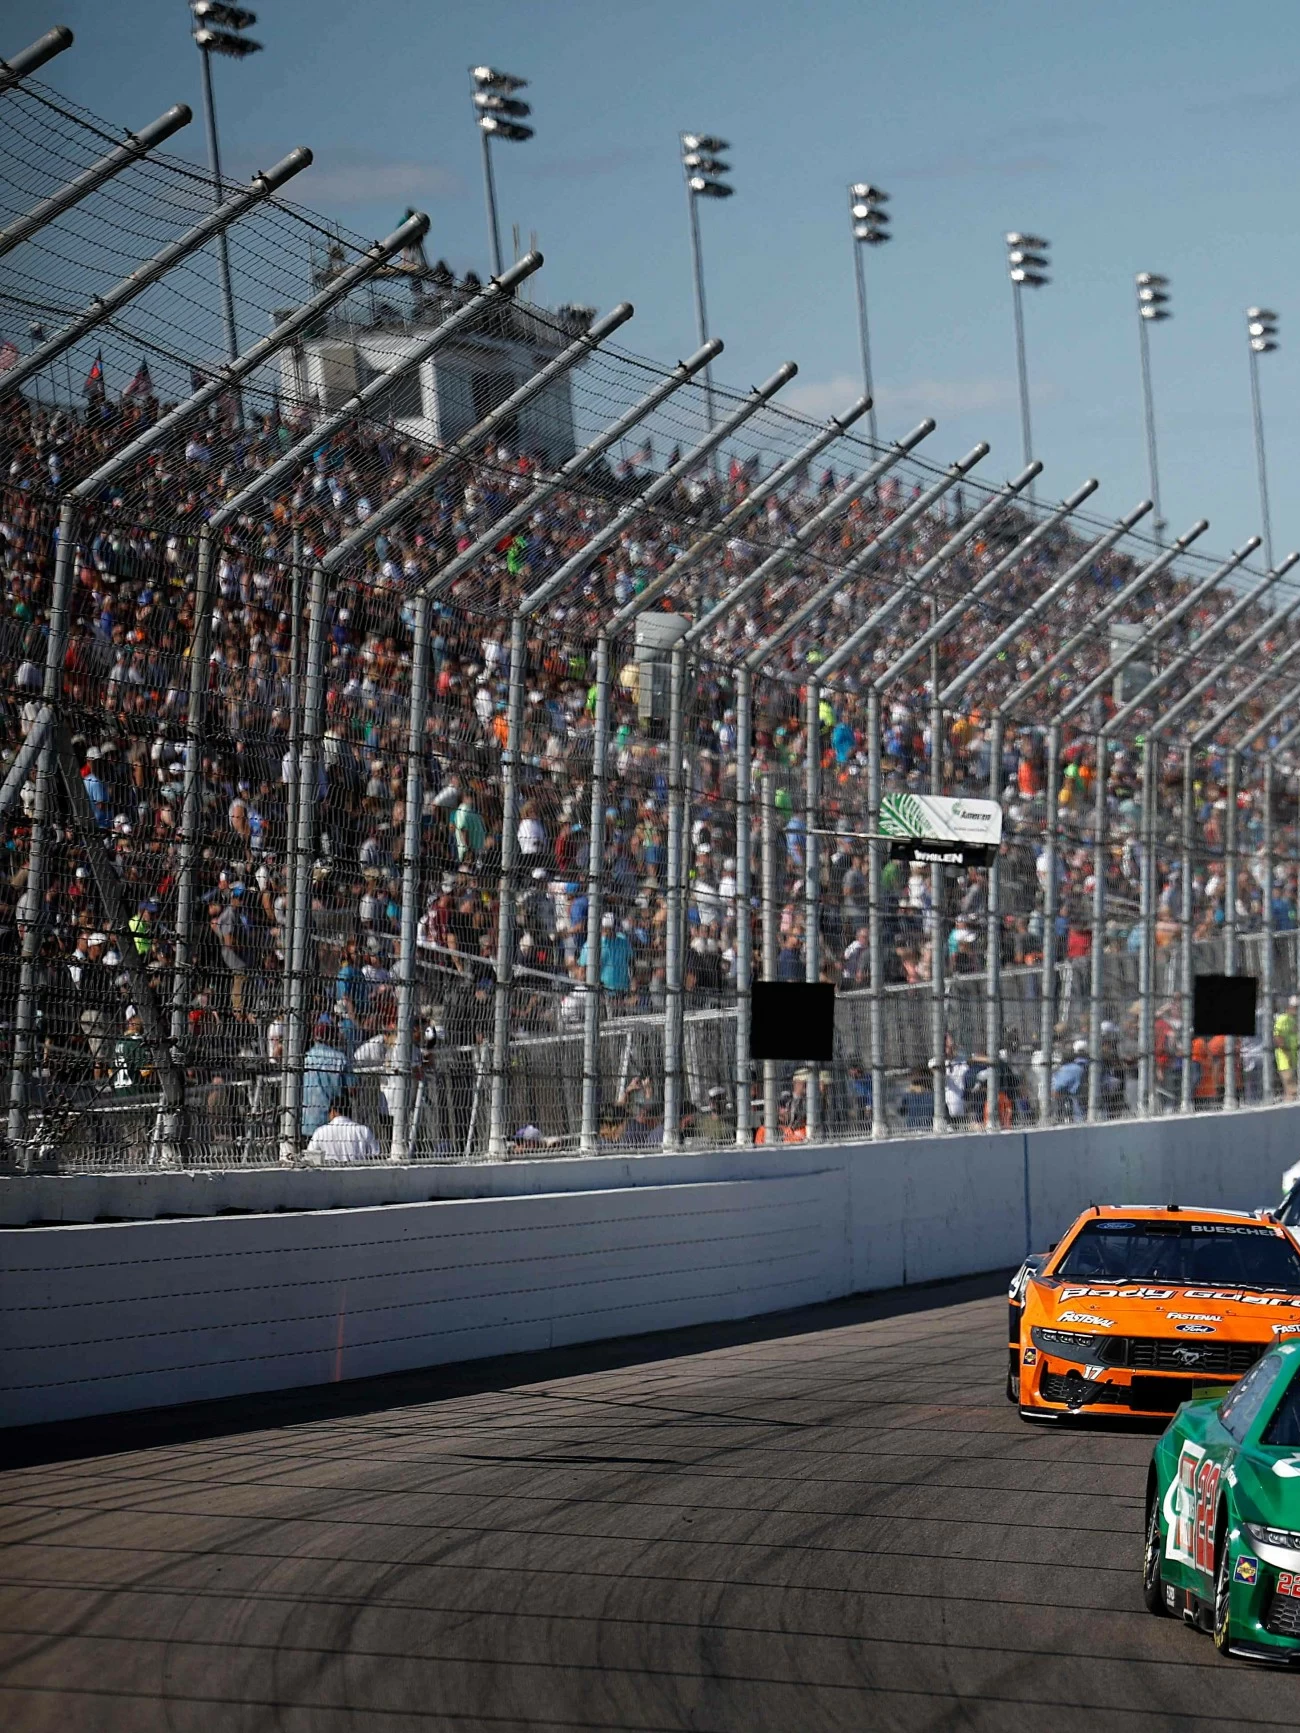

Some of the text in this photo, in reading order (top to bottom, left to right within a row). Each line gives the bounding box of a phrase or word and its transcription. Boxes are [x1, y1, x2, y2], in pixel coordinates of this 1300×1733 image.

[1056, 1310, 1115, 1328] FASTENAL
[1166, 1311, 1222, 1322] FASTENAL
[1083, 1364, 1105, 1380] 17
